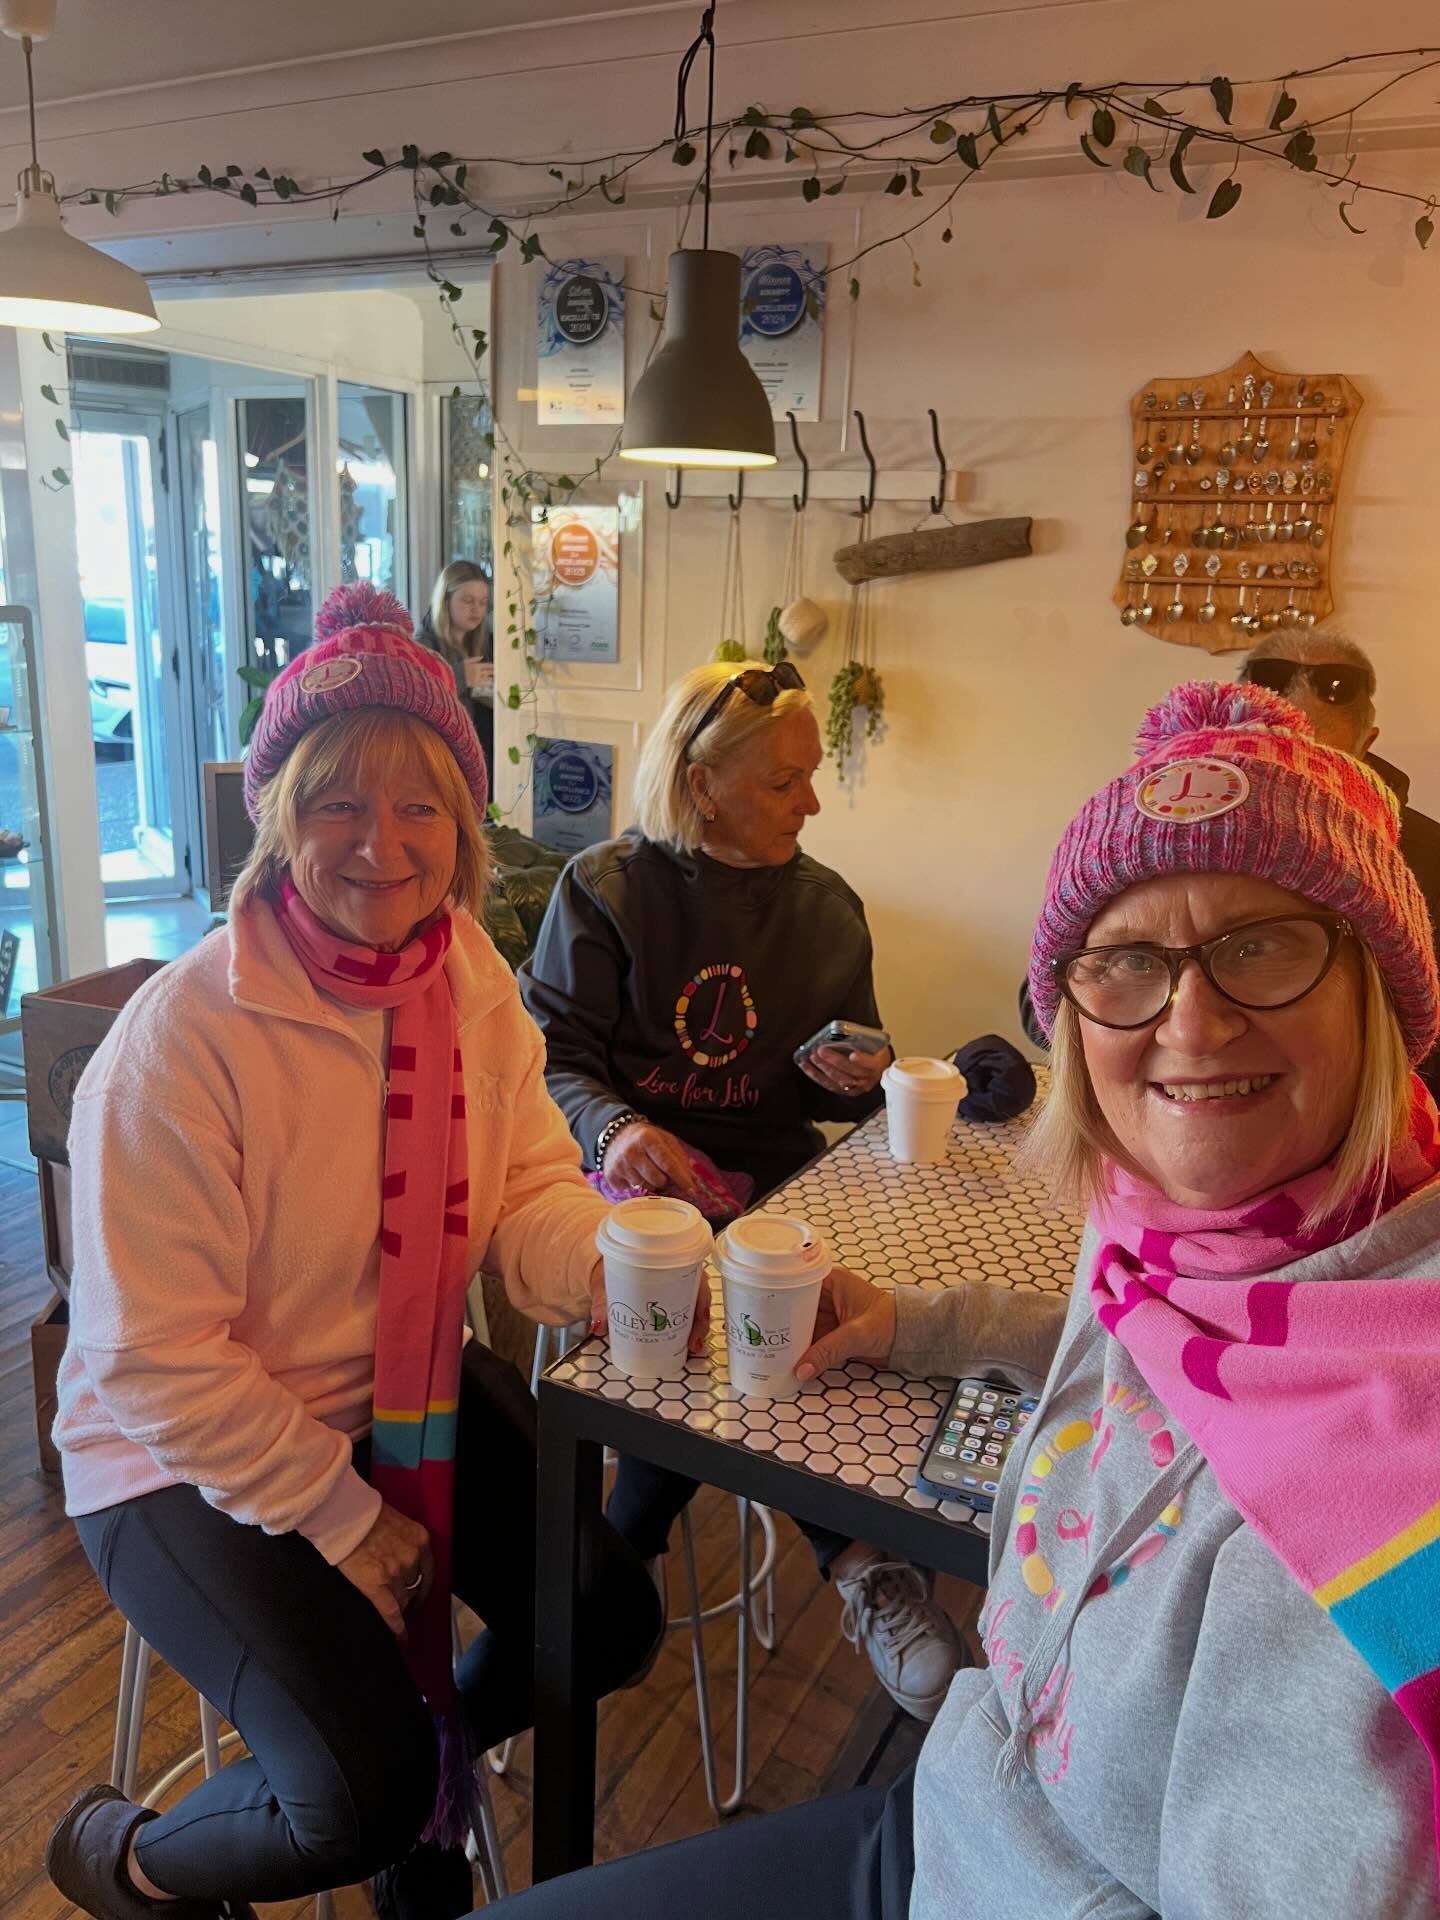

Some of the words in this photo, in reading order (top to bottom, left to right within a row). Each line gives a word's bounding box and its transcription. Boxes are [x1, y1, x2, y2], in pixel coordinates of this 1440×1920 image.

[701, 982, 733, 1045] L
[681, 1072, 715, 1109] for
[719, 1072, 760, 1109] Lily
